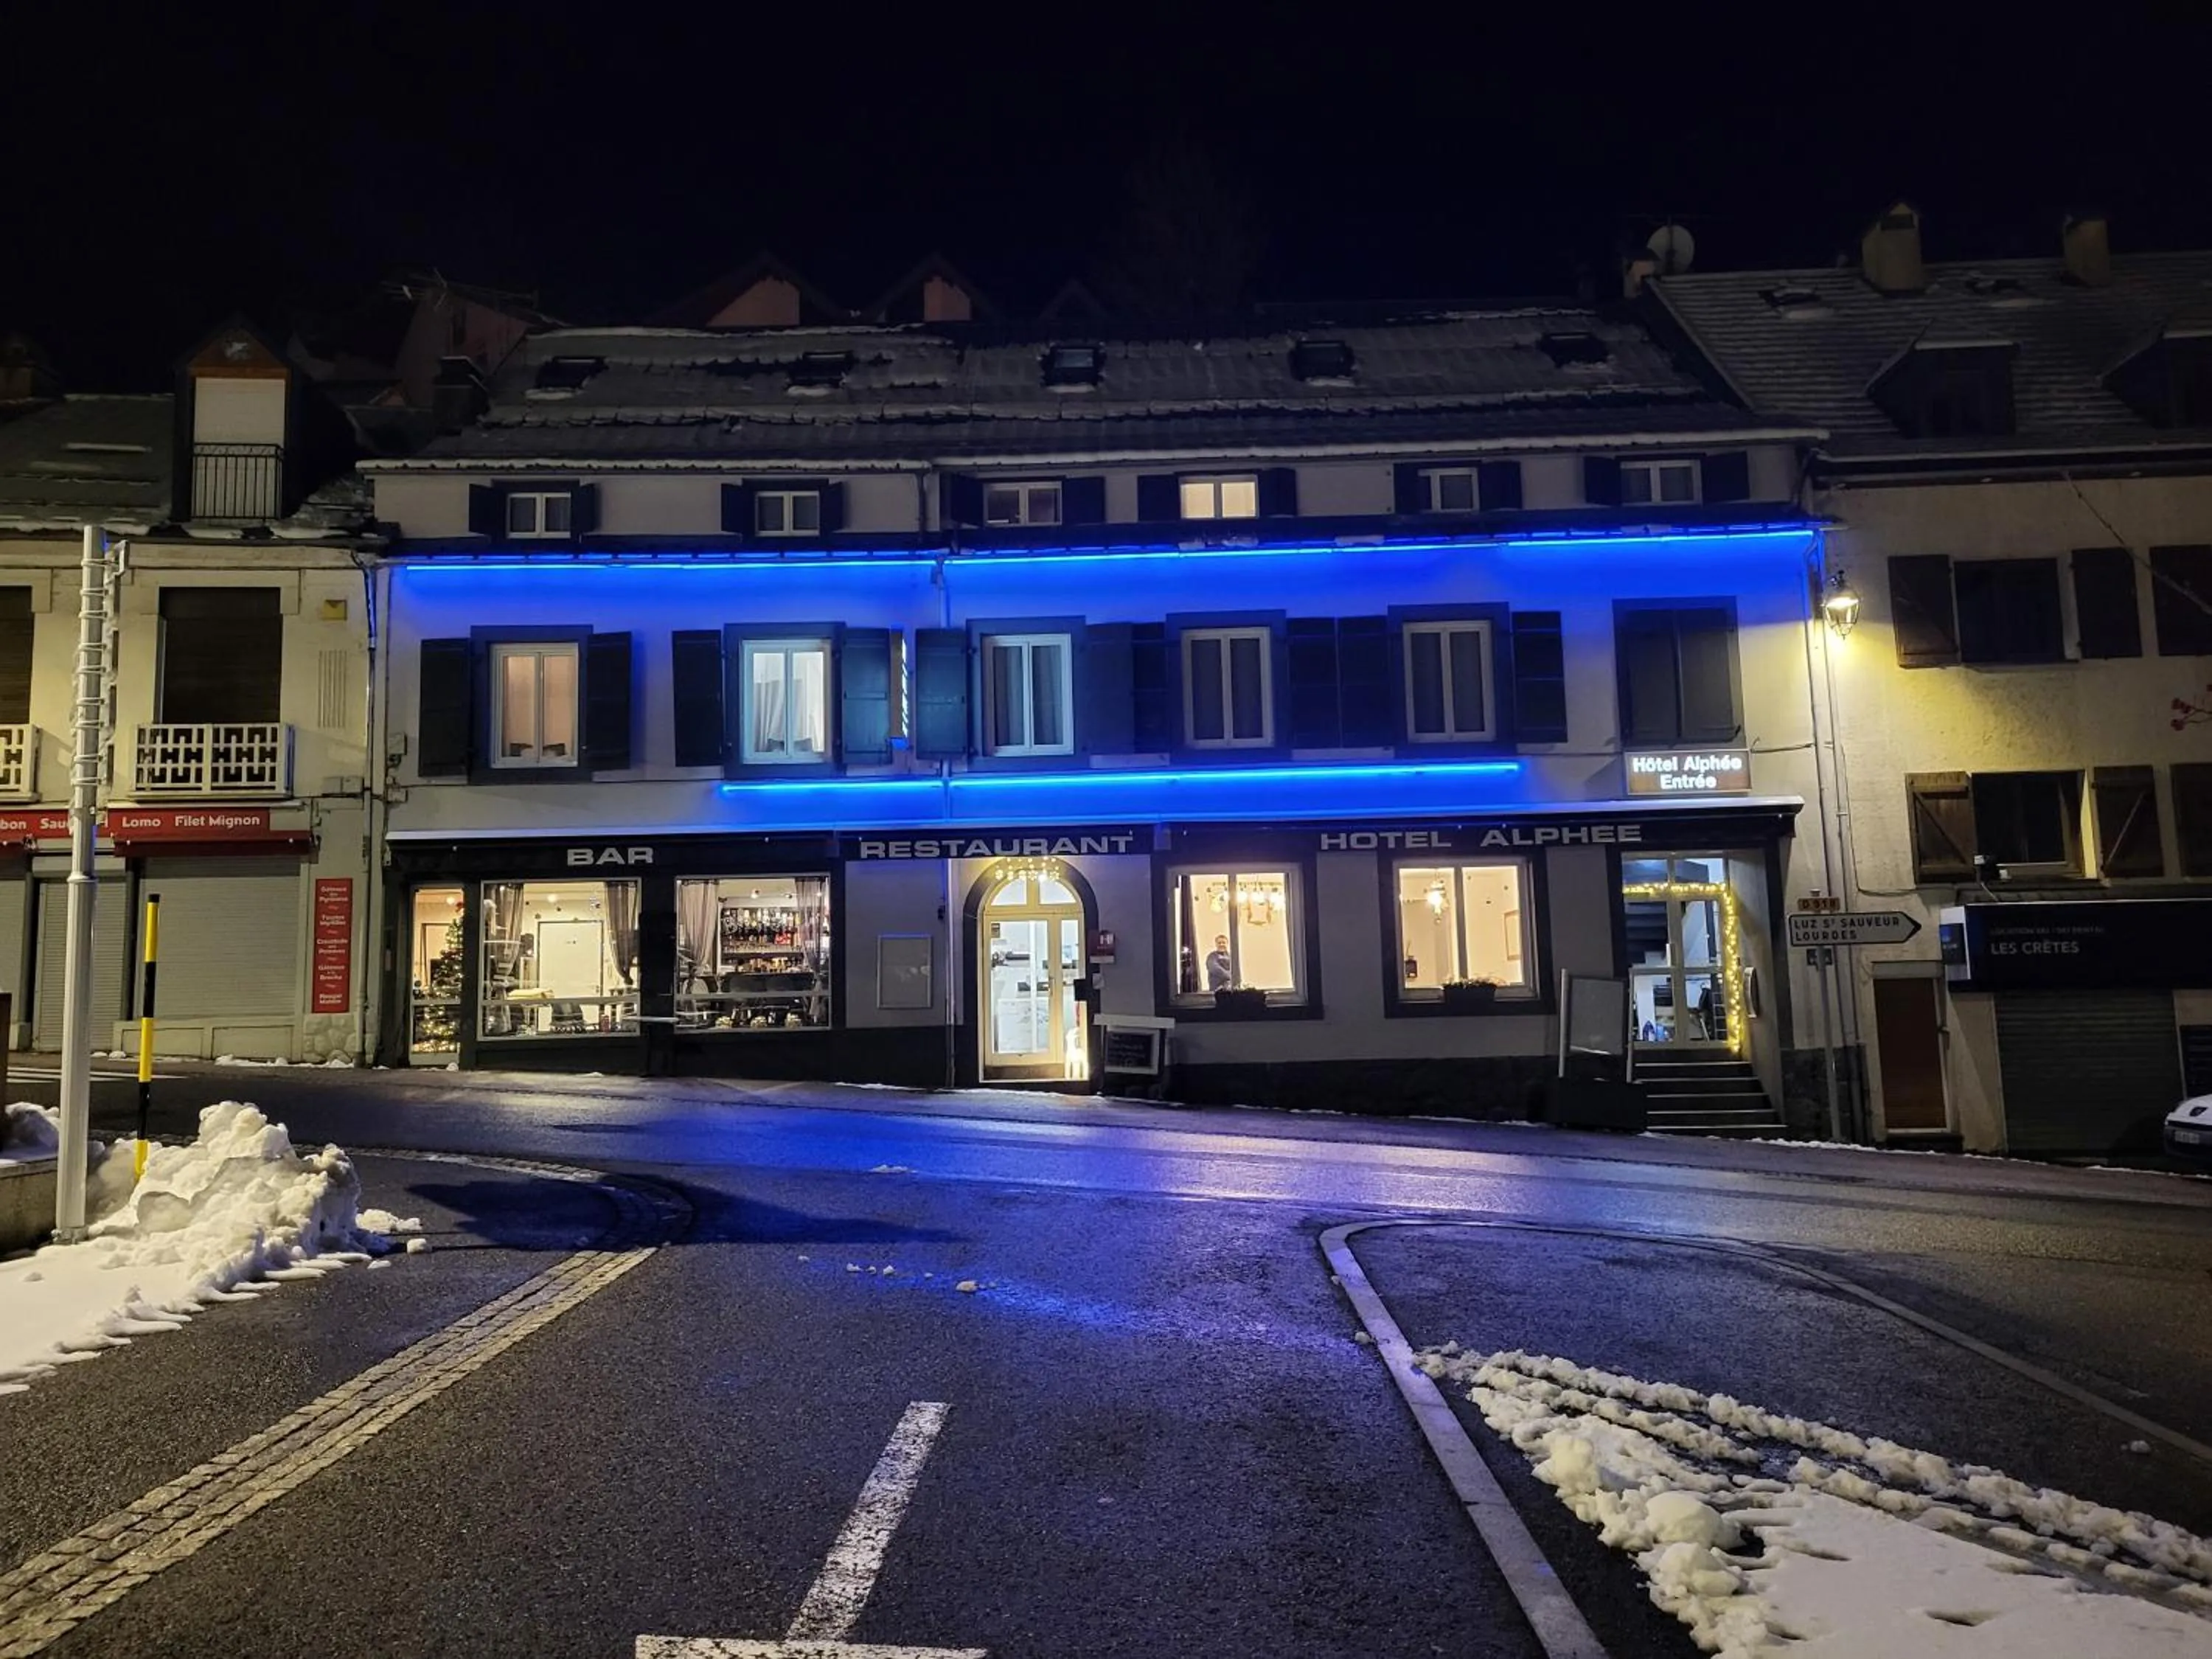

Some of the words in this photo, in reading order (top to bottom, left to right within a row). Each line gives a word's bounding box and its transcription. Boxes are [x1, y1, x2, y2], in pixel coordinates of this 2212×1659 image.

[1632, 756, 1678, 773] Hôtel
[1683, 754, 1742, 773] Alphée
[1660, 773, 1717, 789] Entrée
[40, 818, 69, 830] Sau
[122, 816, 161, 827] Lomo
[175, 815, 206, 827] Filet
[209, 815, 260, 830] Mignon
[1321, 831, 1452, 850] HOTEL
[1480, 824, 1642, 847] ALPHEE
[860, 835, 1133, 859] RESTAURANT
[567, 847, 654, 866] BAR
[1794, 919, 1817, 930] LUZ
[1840, 917, 1899, 928] SAUVEUR
[1795, 930, 1857, 942] LOURDES
[1991, 942, 2017, 955] LES
[2022, 939, 2080, 954] CRÊTES
